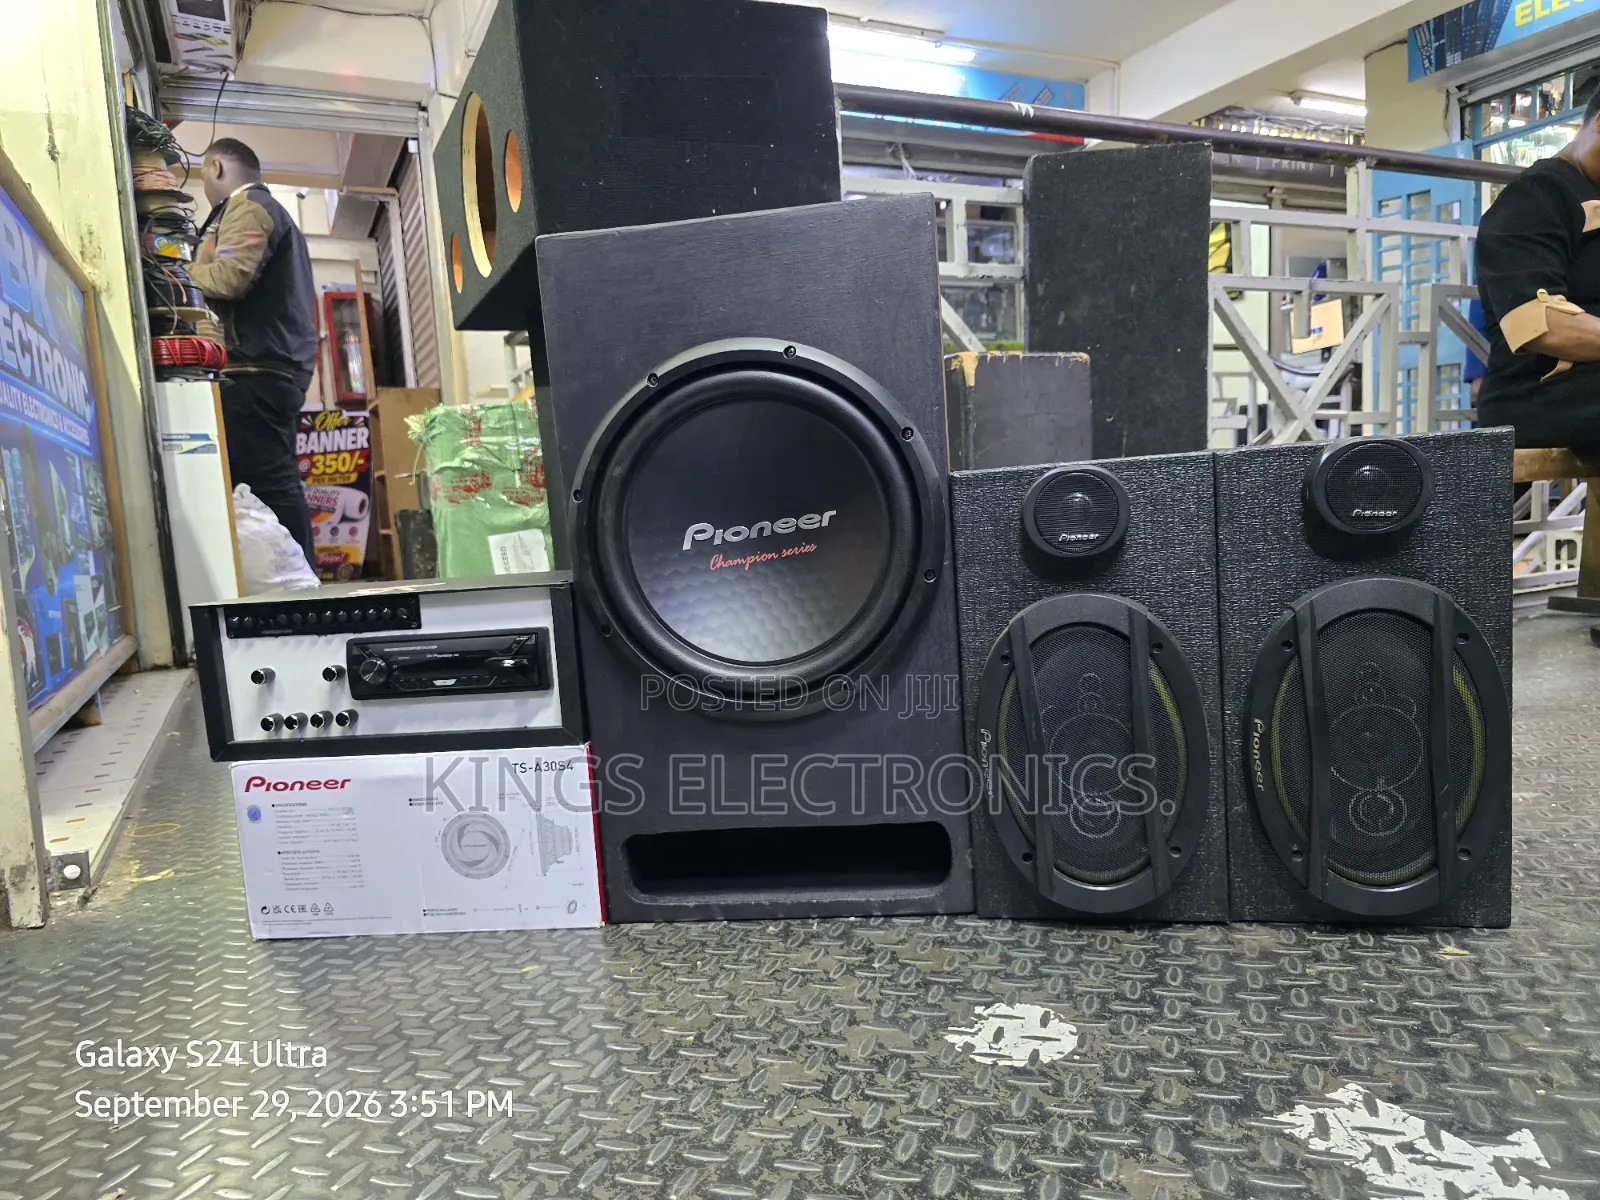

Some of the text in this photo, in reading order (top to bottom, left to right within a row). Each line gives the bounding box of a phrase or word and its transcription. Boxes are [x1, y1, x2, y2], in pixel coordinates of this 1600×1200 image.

[1514, 0, 1585, 27] ELE
[315, 411, 351, 431] Offer
[296, 427, 369, 455] BANNER
[311, 451, 365, 475] 350/-
[682, 510, 837, 550] Pioneer
[709, 542, 817, 571] Champion series
[511, 761, 574, 774] TS-A30S4
[1253, 717, 1265, 792] Pioneer
[244, 776, 351, 792] Pioneer
